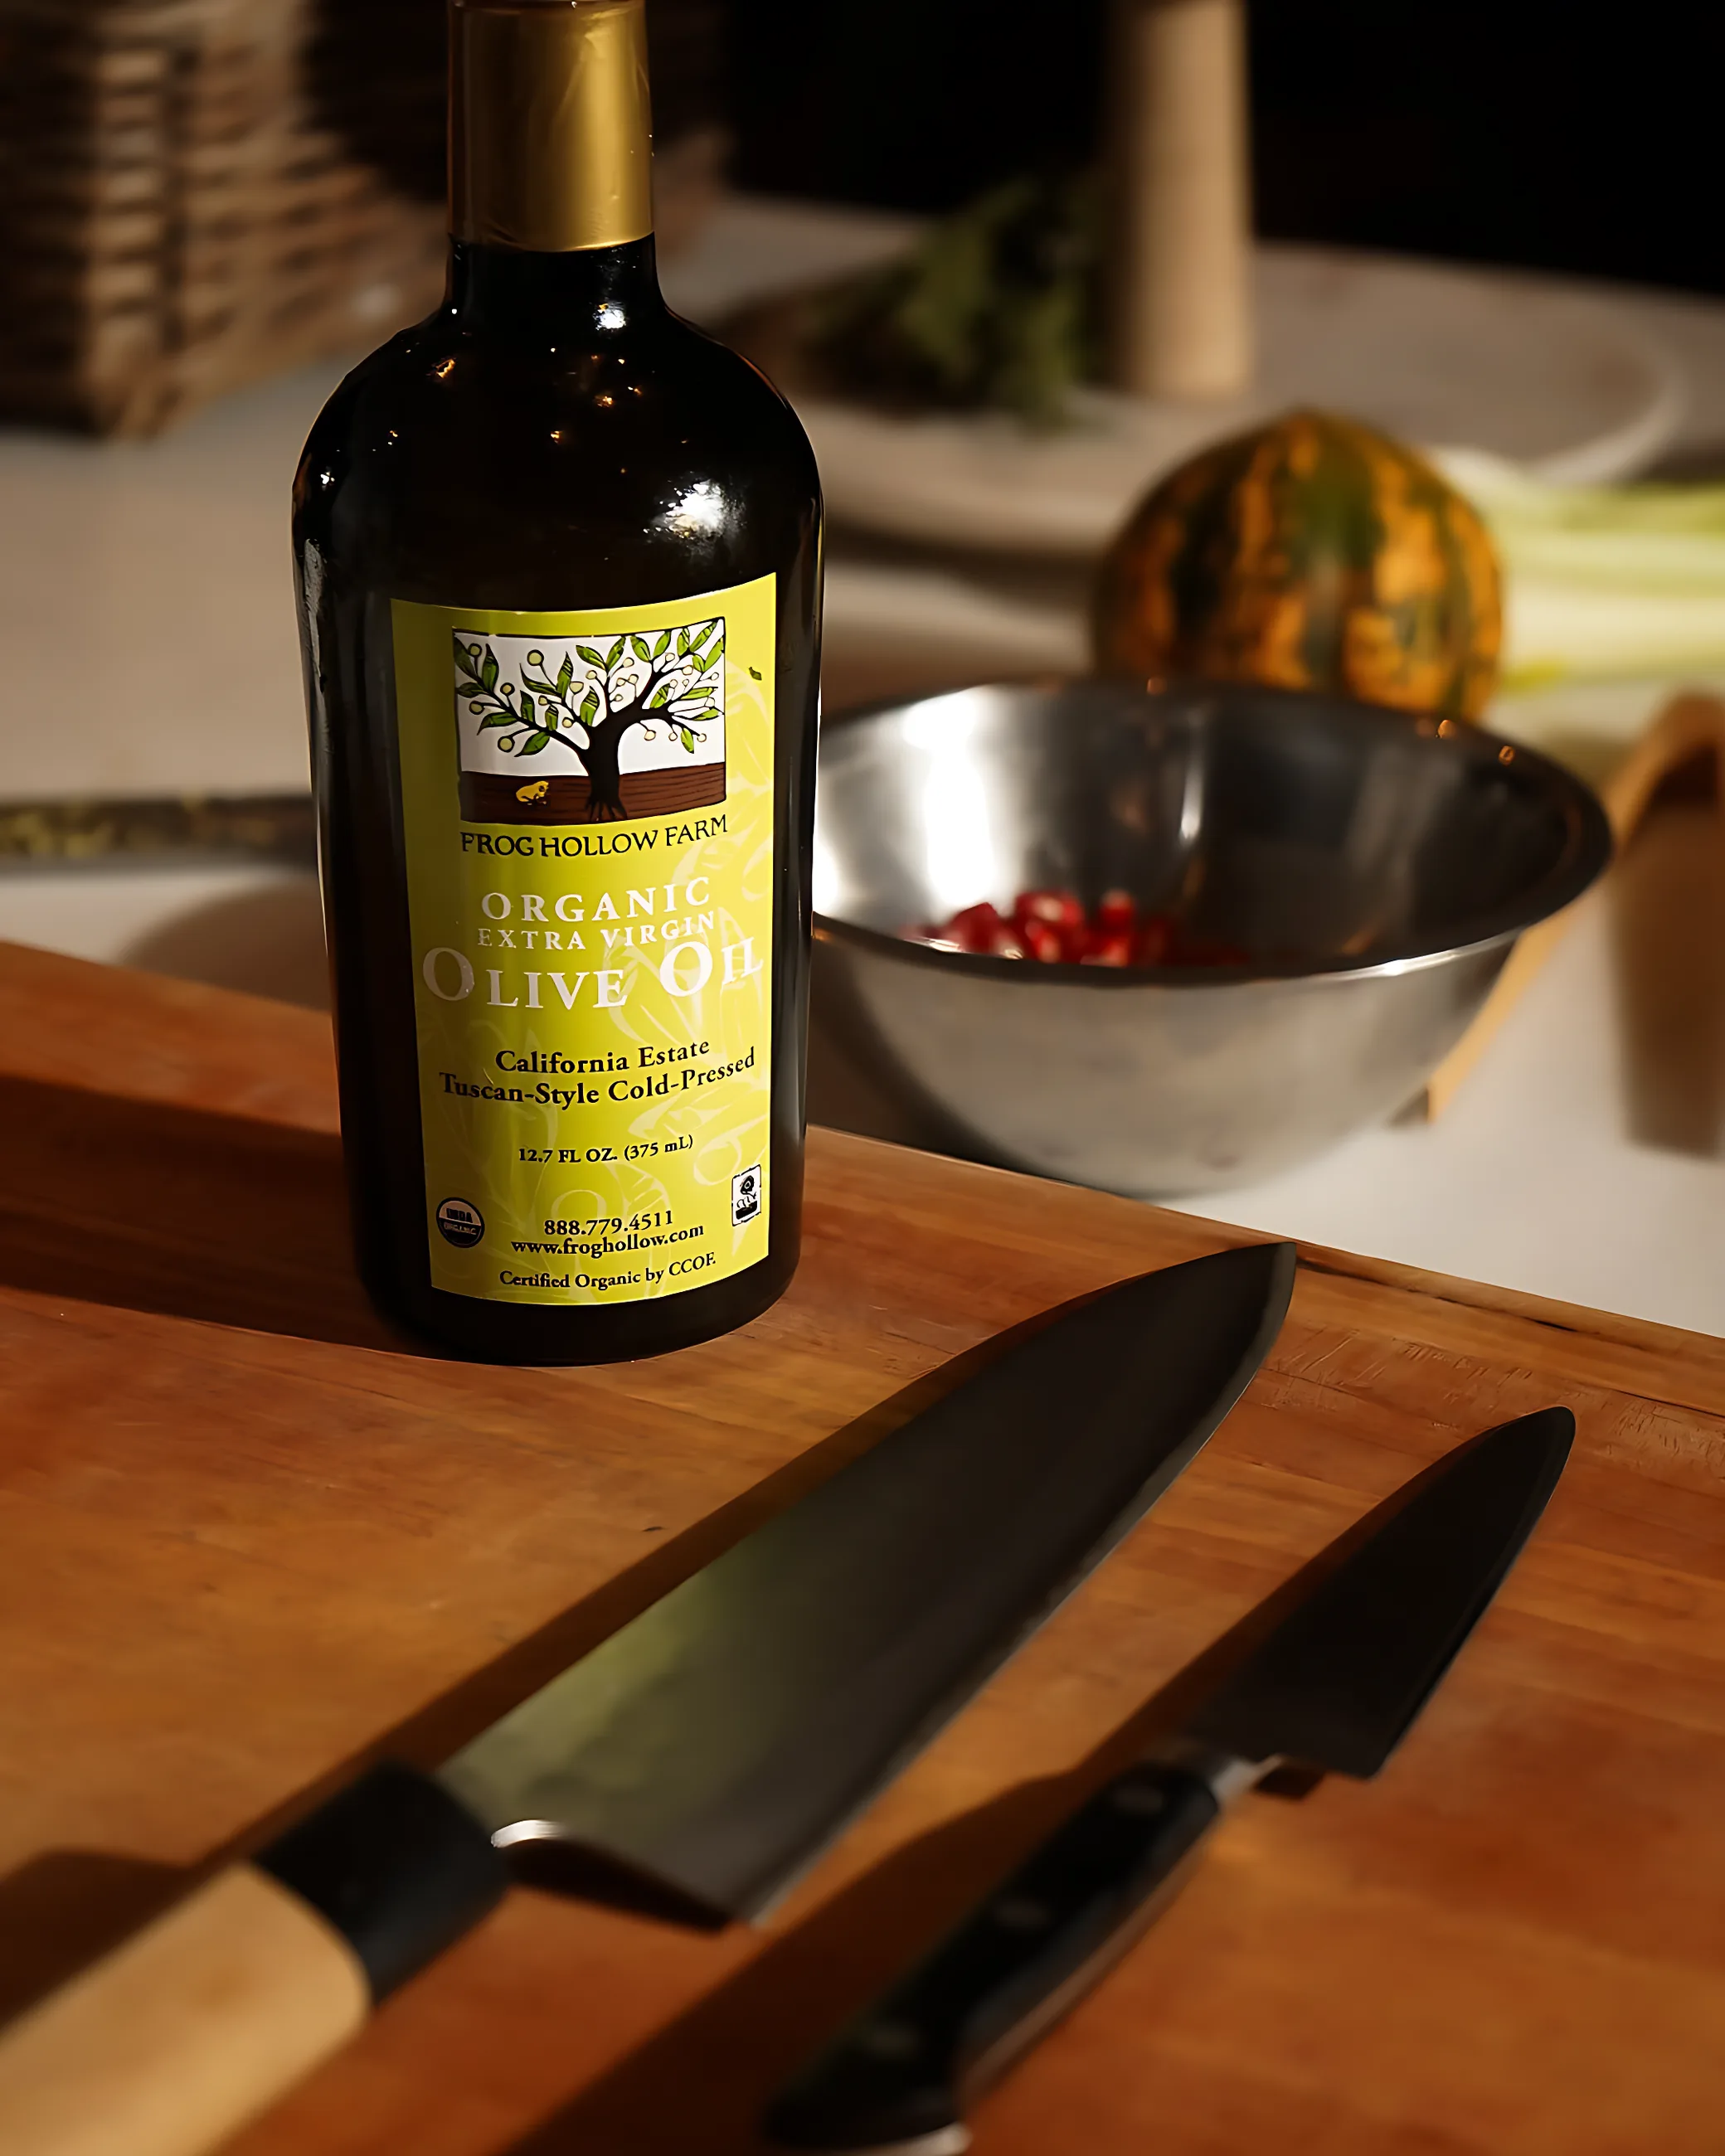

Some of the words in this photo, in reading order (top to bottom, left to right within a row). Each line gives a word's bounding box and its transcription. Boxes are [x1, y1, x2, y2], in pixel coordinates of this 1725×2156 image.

[460, 832, 533, 857] FROG
[540, 830, 658, 857] HOLLOW
[666, 814, 728, 847] FARM
[481, 876, 710, 923] ORGANIC
[479, 928, 586, 950] EXTRA
[601, 910, 714, 949] VIRGIN
[423, 947, 627, 1010] OLIVE
[659, 936, 763, 997] OIL
[495, 1051, 630, 1074] California
[638, 1041, 710, 1068] Estate
[439, 1072, 600, 1110] Tuscan-Style
[608, 1046, 756, 1102] Cold-Pressed
[519, 1148, 552, 1163] 12.7
[558, 1149, 581, 1163] FL
[586, 1148, 618, 1163] OZ.
[624, 1144, 659, 1162] (375
[664, 1134, 693, 1153] mL)
[544, 1210, 673, 1236] 888.779.4511
[511, 1226, 704, 1259] www.froghollow.com
[499, 1270, 571, 1288] Certified
[575, 1270, 641, 1290] Organic
[645, 1267, 664, 1283] by
